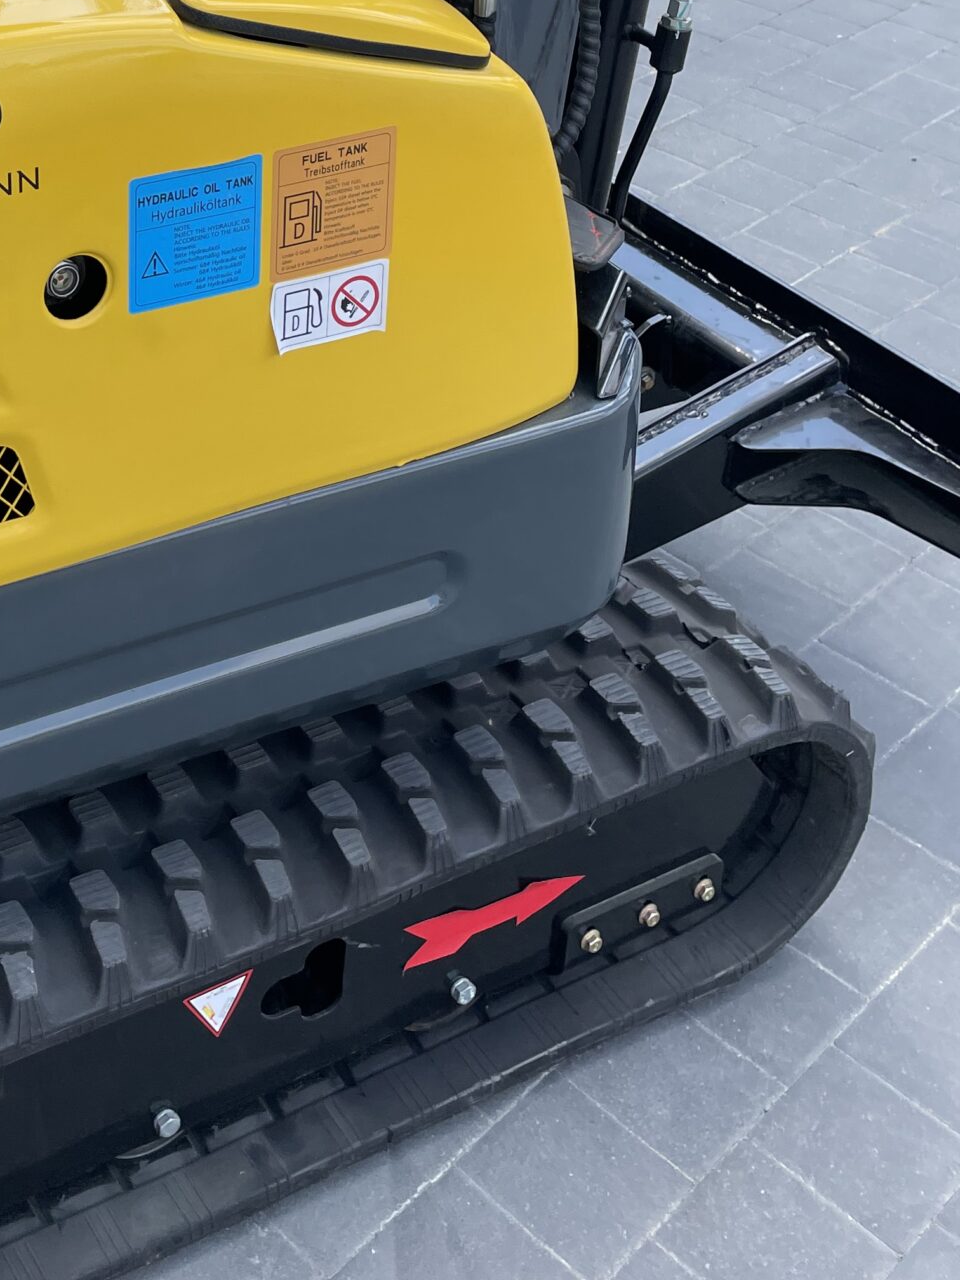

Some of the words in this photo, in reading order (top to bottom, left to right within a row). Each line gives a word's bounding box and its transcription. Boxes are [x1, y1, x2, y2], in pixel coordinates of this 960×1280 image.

[302, 151, 332, 166] FUEL
[338, 142, 368, 158] TANK
[303, 156, 366, 178] Treibstofftank
[138, 187, 199, 208] HYDRAULIC
[204, 183, 220, 194] OIL
[226, 175, 254, 190] TANK
[151, 193, 242, 224] Hydrauliköltank
[294, 223, 305, 239] D
